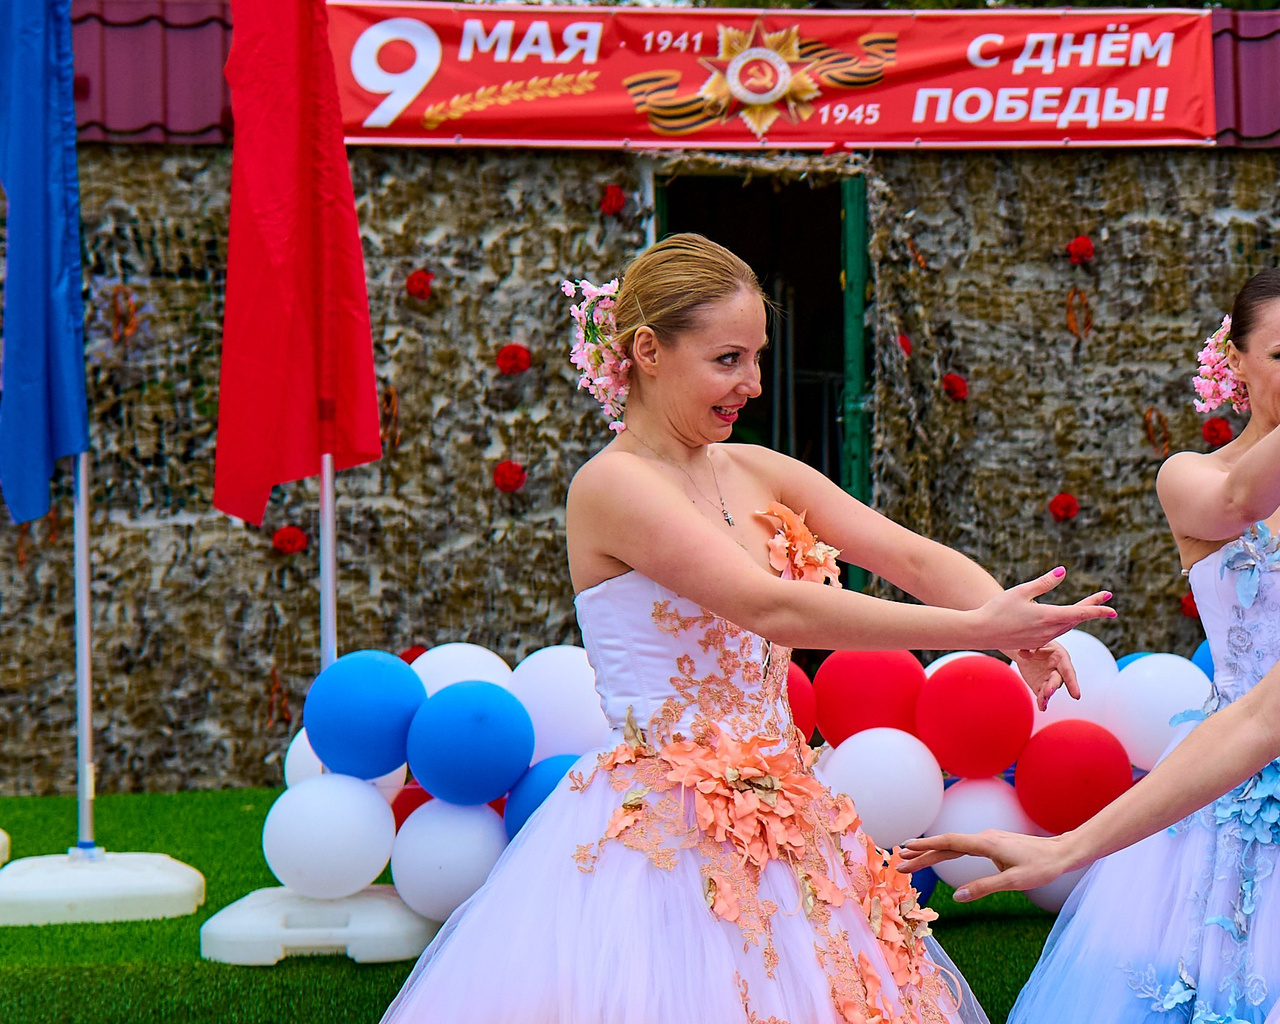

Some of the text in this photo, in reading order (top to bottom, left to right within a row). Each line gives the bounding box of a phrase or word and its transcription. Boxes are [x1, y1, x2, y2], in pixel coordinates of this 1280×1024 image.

[642, 31, 703, 53] 1941
[966, 23, 1175, 75] С ДНЁМ
[350, 17, 604, 128] 9 МАЯ
[818, 103, 881, 126] 1945
[911, 87, 1170, 129] ПОБЕДЫ!
